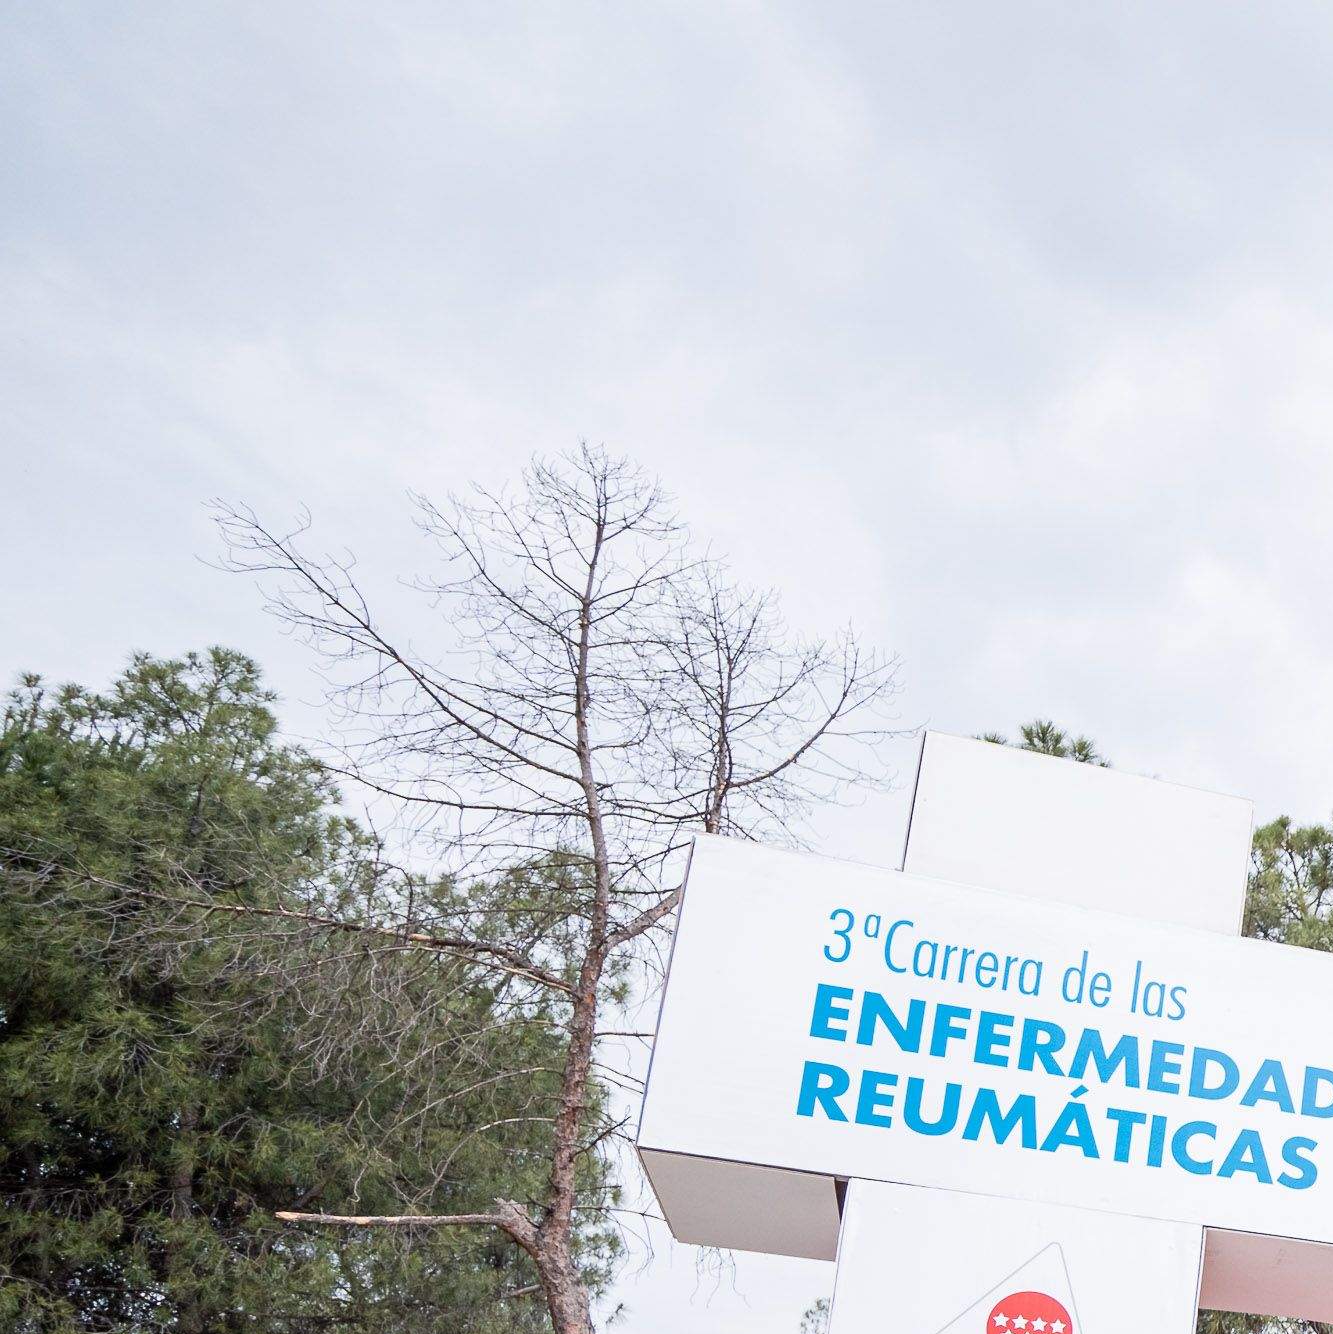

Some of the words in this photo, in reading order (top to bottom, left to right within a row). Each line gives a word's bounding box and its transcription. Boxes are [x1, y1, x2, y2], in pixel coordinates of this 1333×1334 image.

[1061, 951, 1110, 1006] de
[1134, 959, 1188, 1021] las
[796, 1060, 1318, 1191] REUMÁTICAS
